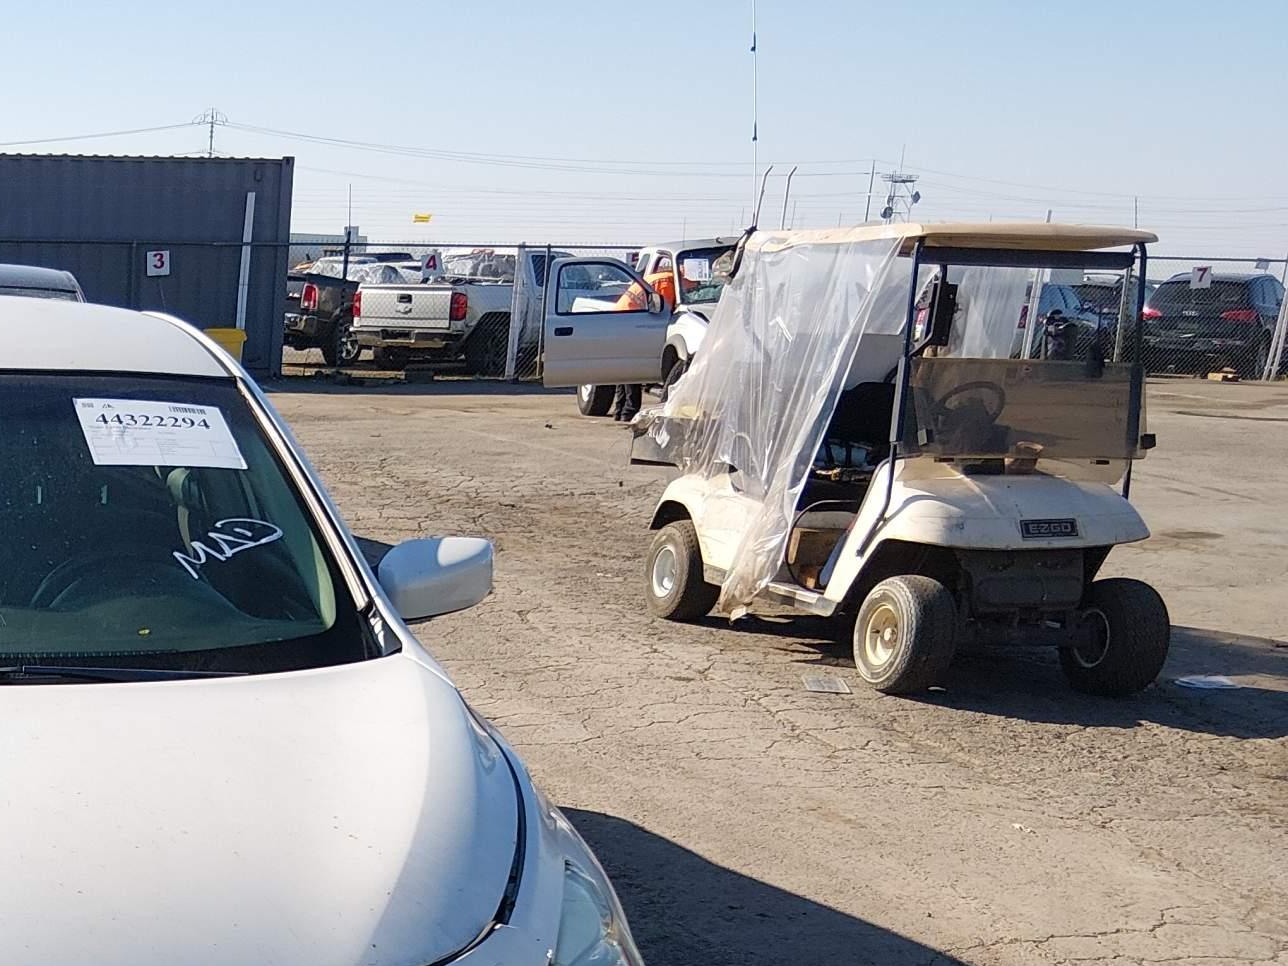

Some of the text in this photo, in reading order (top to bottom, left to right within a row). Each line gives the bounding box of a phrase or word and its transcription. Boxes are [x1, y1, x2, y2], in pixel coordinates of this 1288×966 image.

[152, 253, 165, 269] 3
[425, 255, 438, 271] 4
[1196, 267, 1209, 283] 7
[95, 413, 211, 430] 44322294
